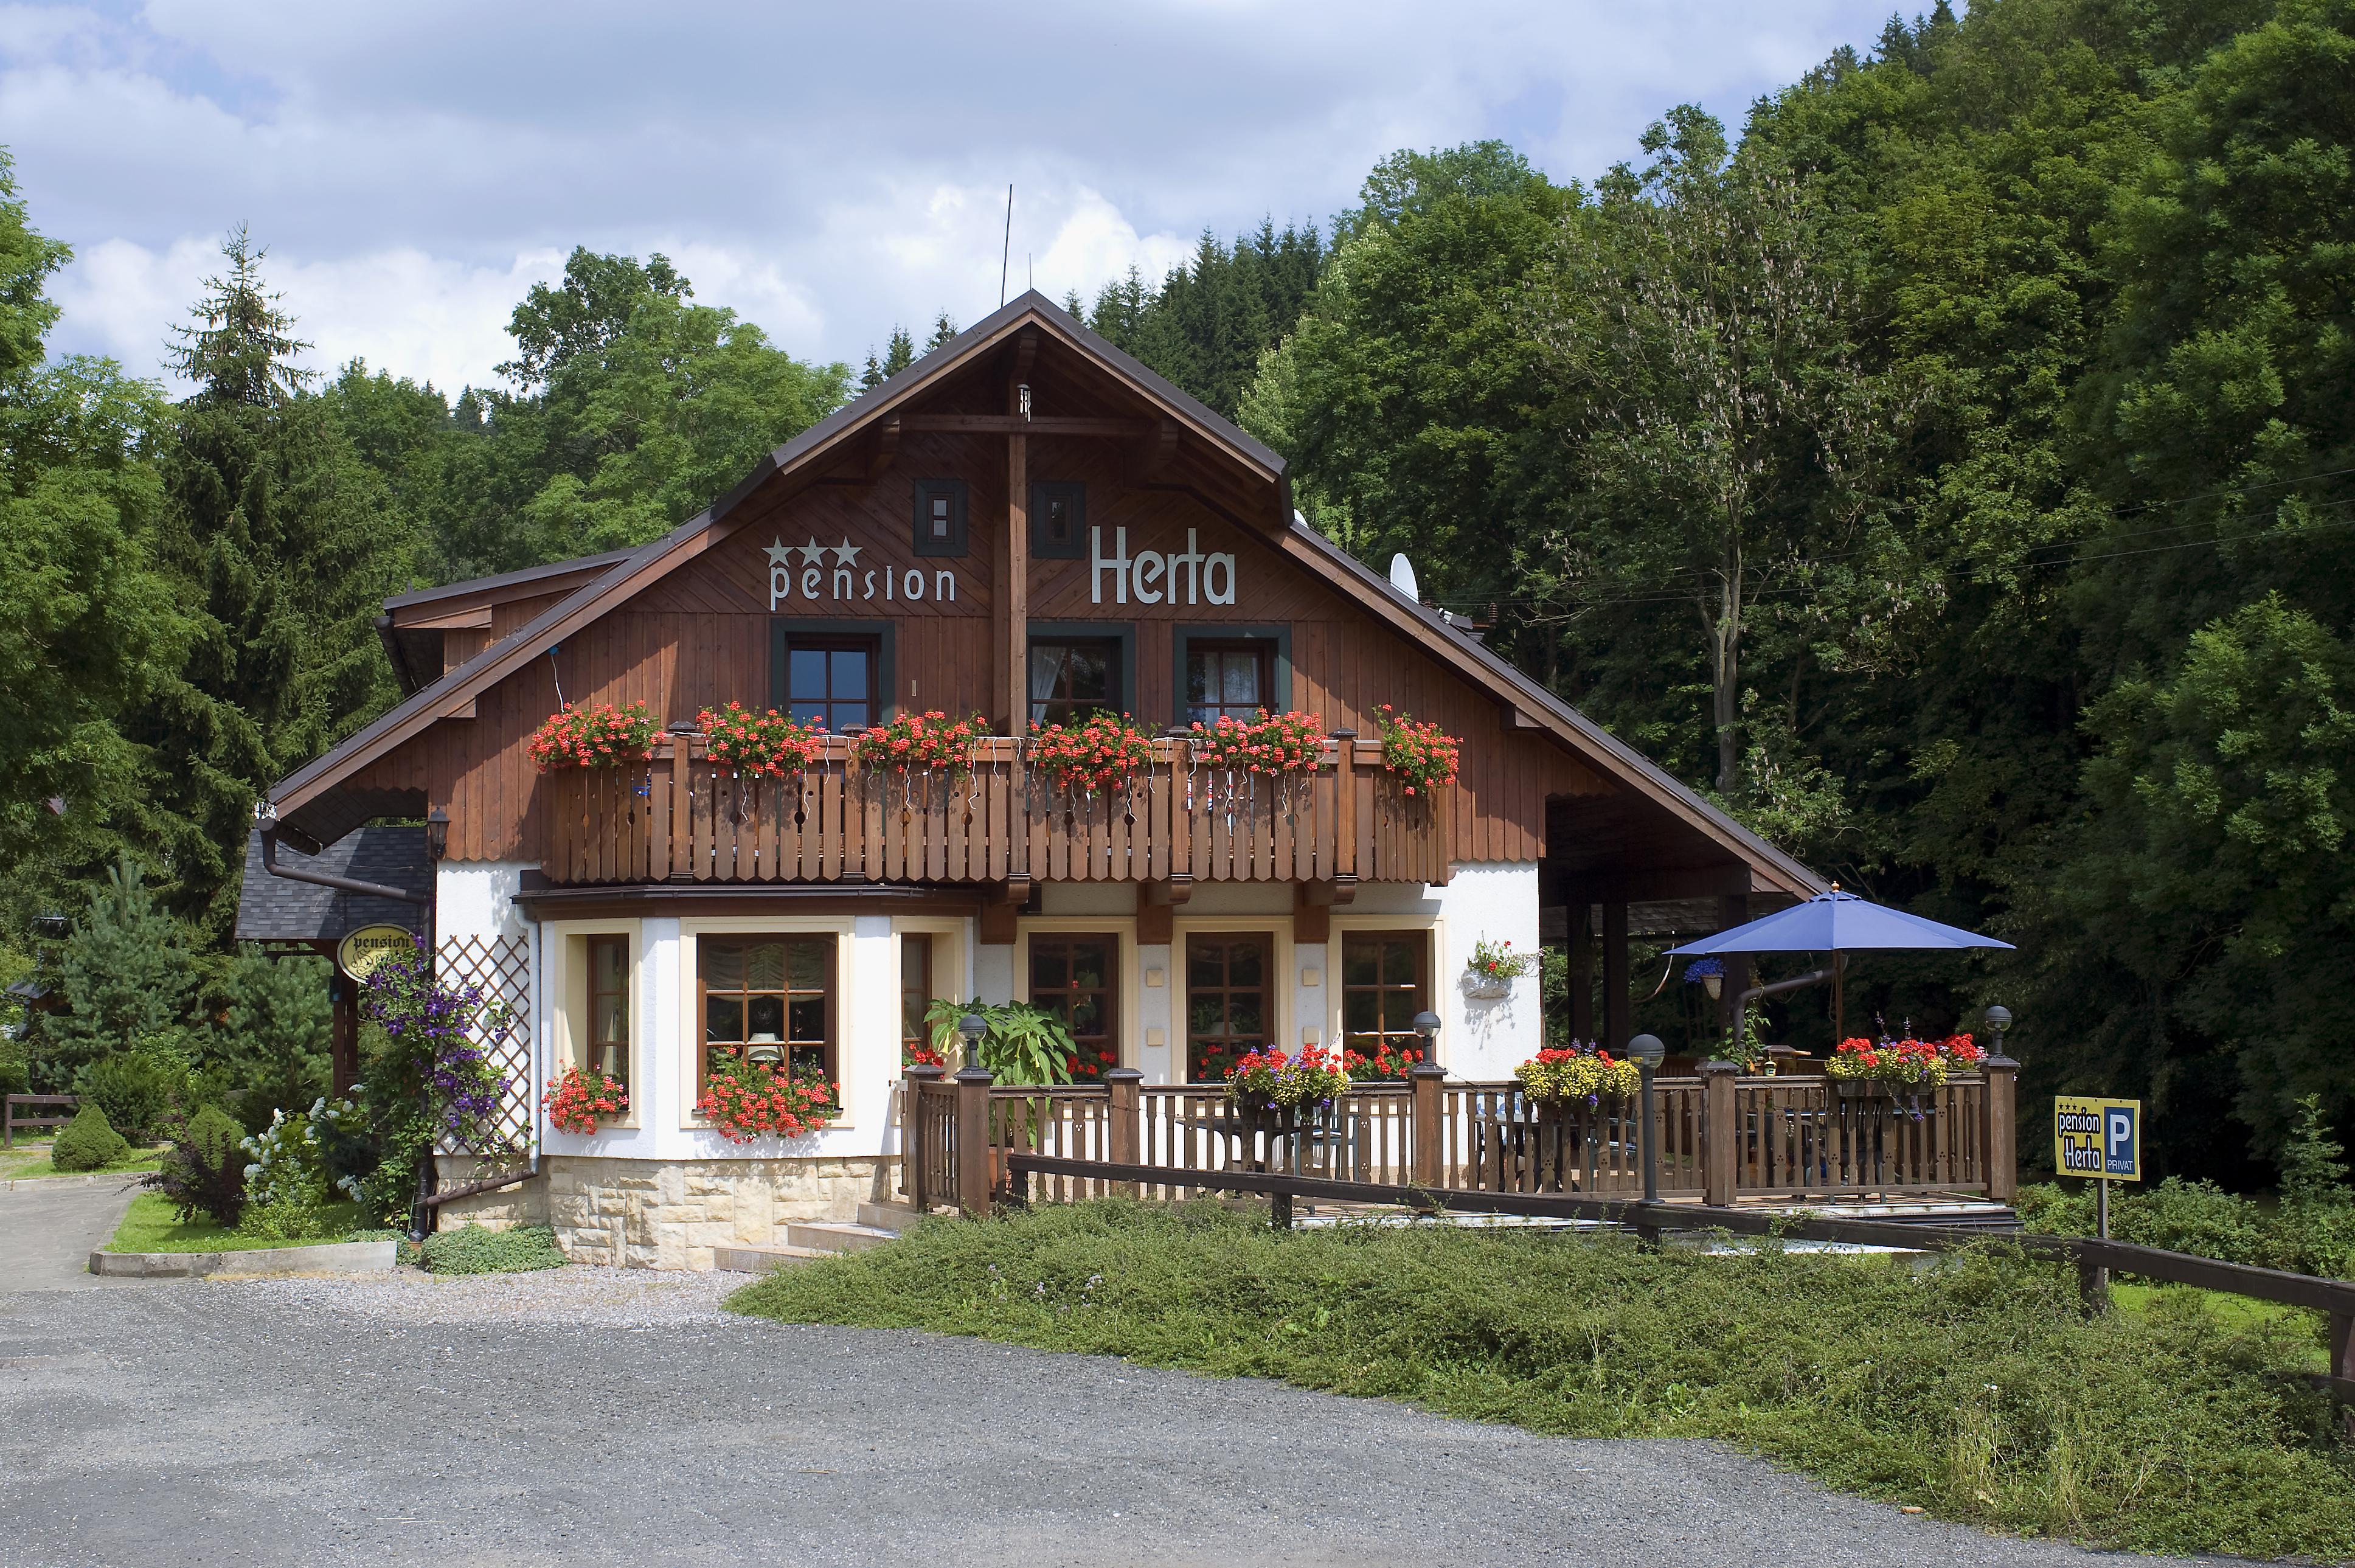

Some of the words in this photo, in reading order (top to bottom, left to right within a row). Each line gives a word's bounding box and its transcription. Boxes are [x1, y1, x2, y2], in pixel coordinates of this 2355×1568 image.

[770, 566, 956, 611] pension
[1092, 526, 1235, 605] Herta
[353, 935, 409, 951] pension
[2059, 1108, 2100, 1136] pension
[2110, 1114, 2131, 1156] P
[2064, 1137, 2101, 1170] Herta
[2107, 1159, 2133, 1171] PRIVAT
